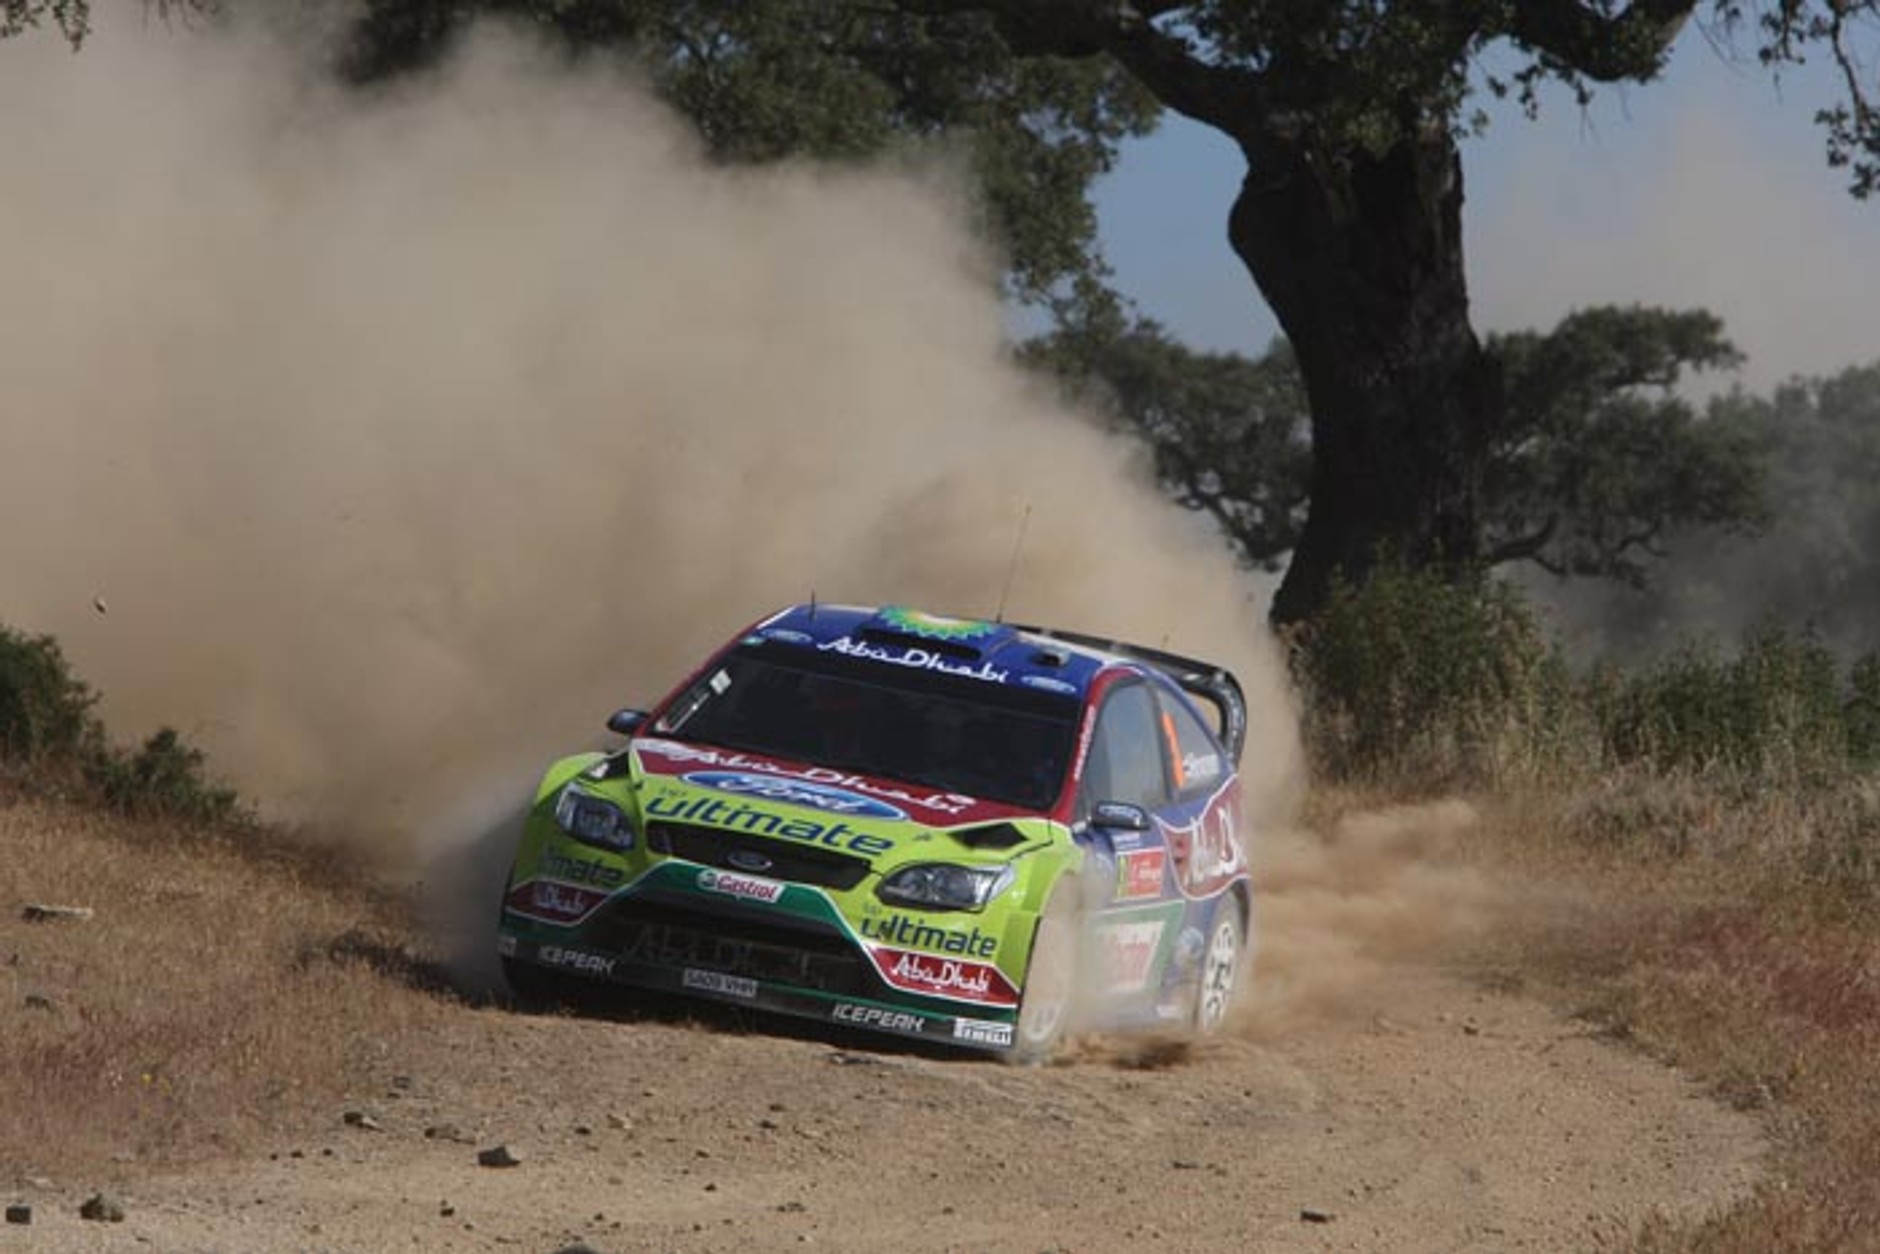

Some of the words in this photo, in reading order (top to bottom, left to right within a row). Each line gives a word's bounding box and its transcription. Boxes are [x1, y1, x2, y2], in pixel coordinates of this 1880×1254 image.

[646, 796, 894, 857] ultimate
[716, 874, 778, 899] Castrol
[861, 914, 998, 957] ultimate
[832, 1003, 925, 1033] ICEPEAK
